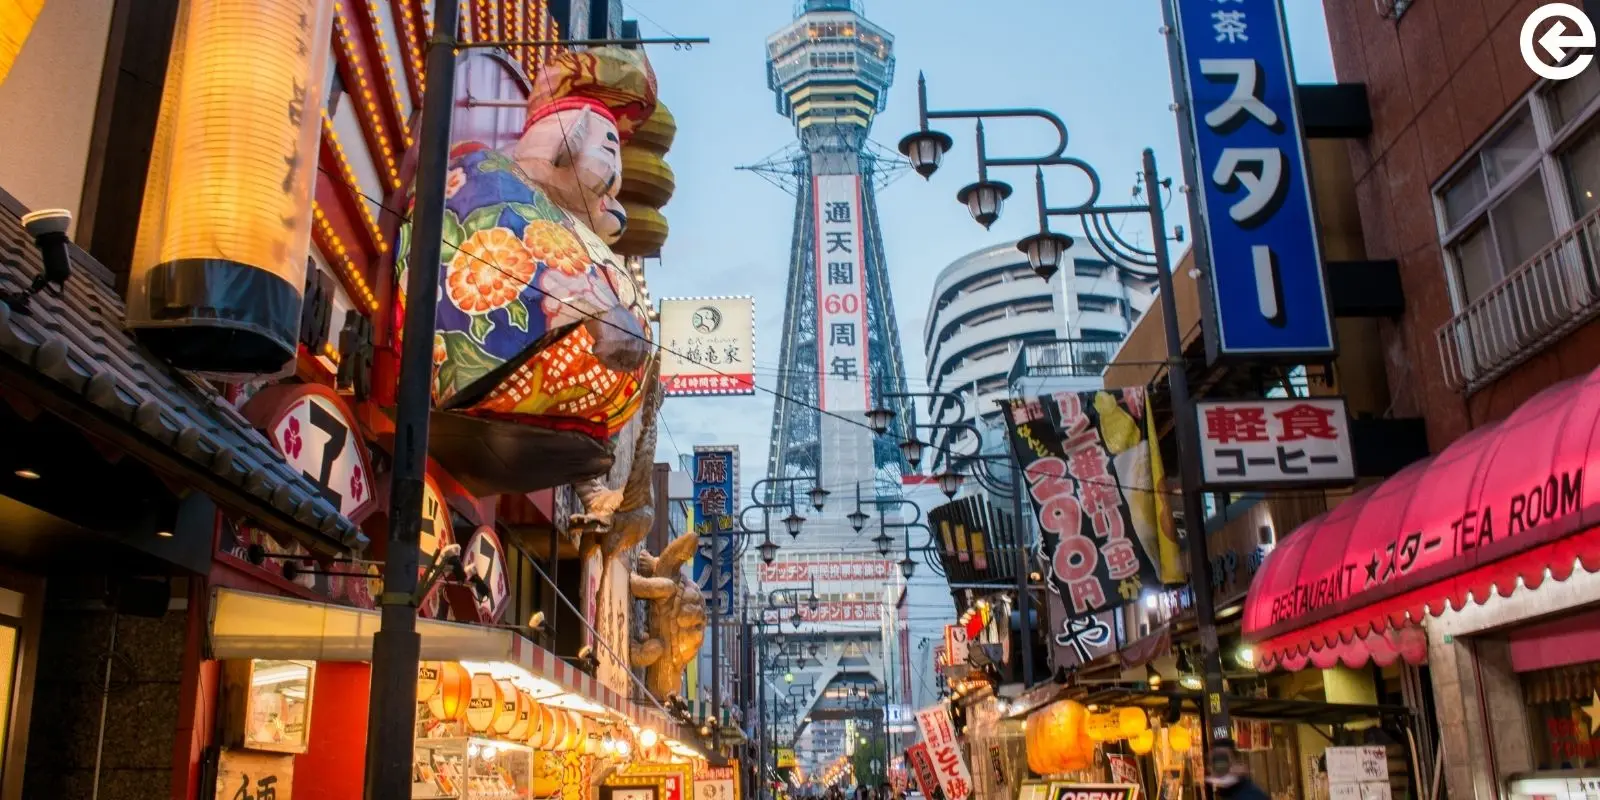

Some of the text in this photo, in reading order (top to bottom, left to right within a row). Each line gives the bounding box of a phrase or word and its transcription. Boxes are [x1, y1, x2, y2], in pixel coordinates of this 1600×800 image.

[1210, 0, 1249, 44] 茶
[1199, 58, 1282, 320] スター
[825, 201, 859, 383] 通天閣60周年
[1205, 404, 1338, 444] 軽食
[694, 451, 729, 516] 麻雀
[1214, 446, 1338, 477] コーヒー
[1272, 564, 1357, 625] RESTAURANT
[1451, 504, 1494, 557] TEA
[1508, 467, 1582, 537] ROOM
[1055, 612, 1112, 665] や
